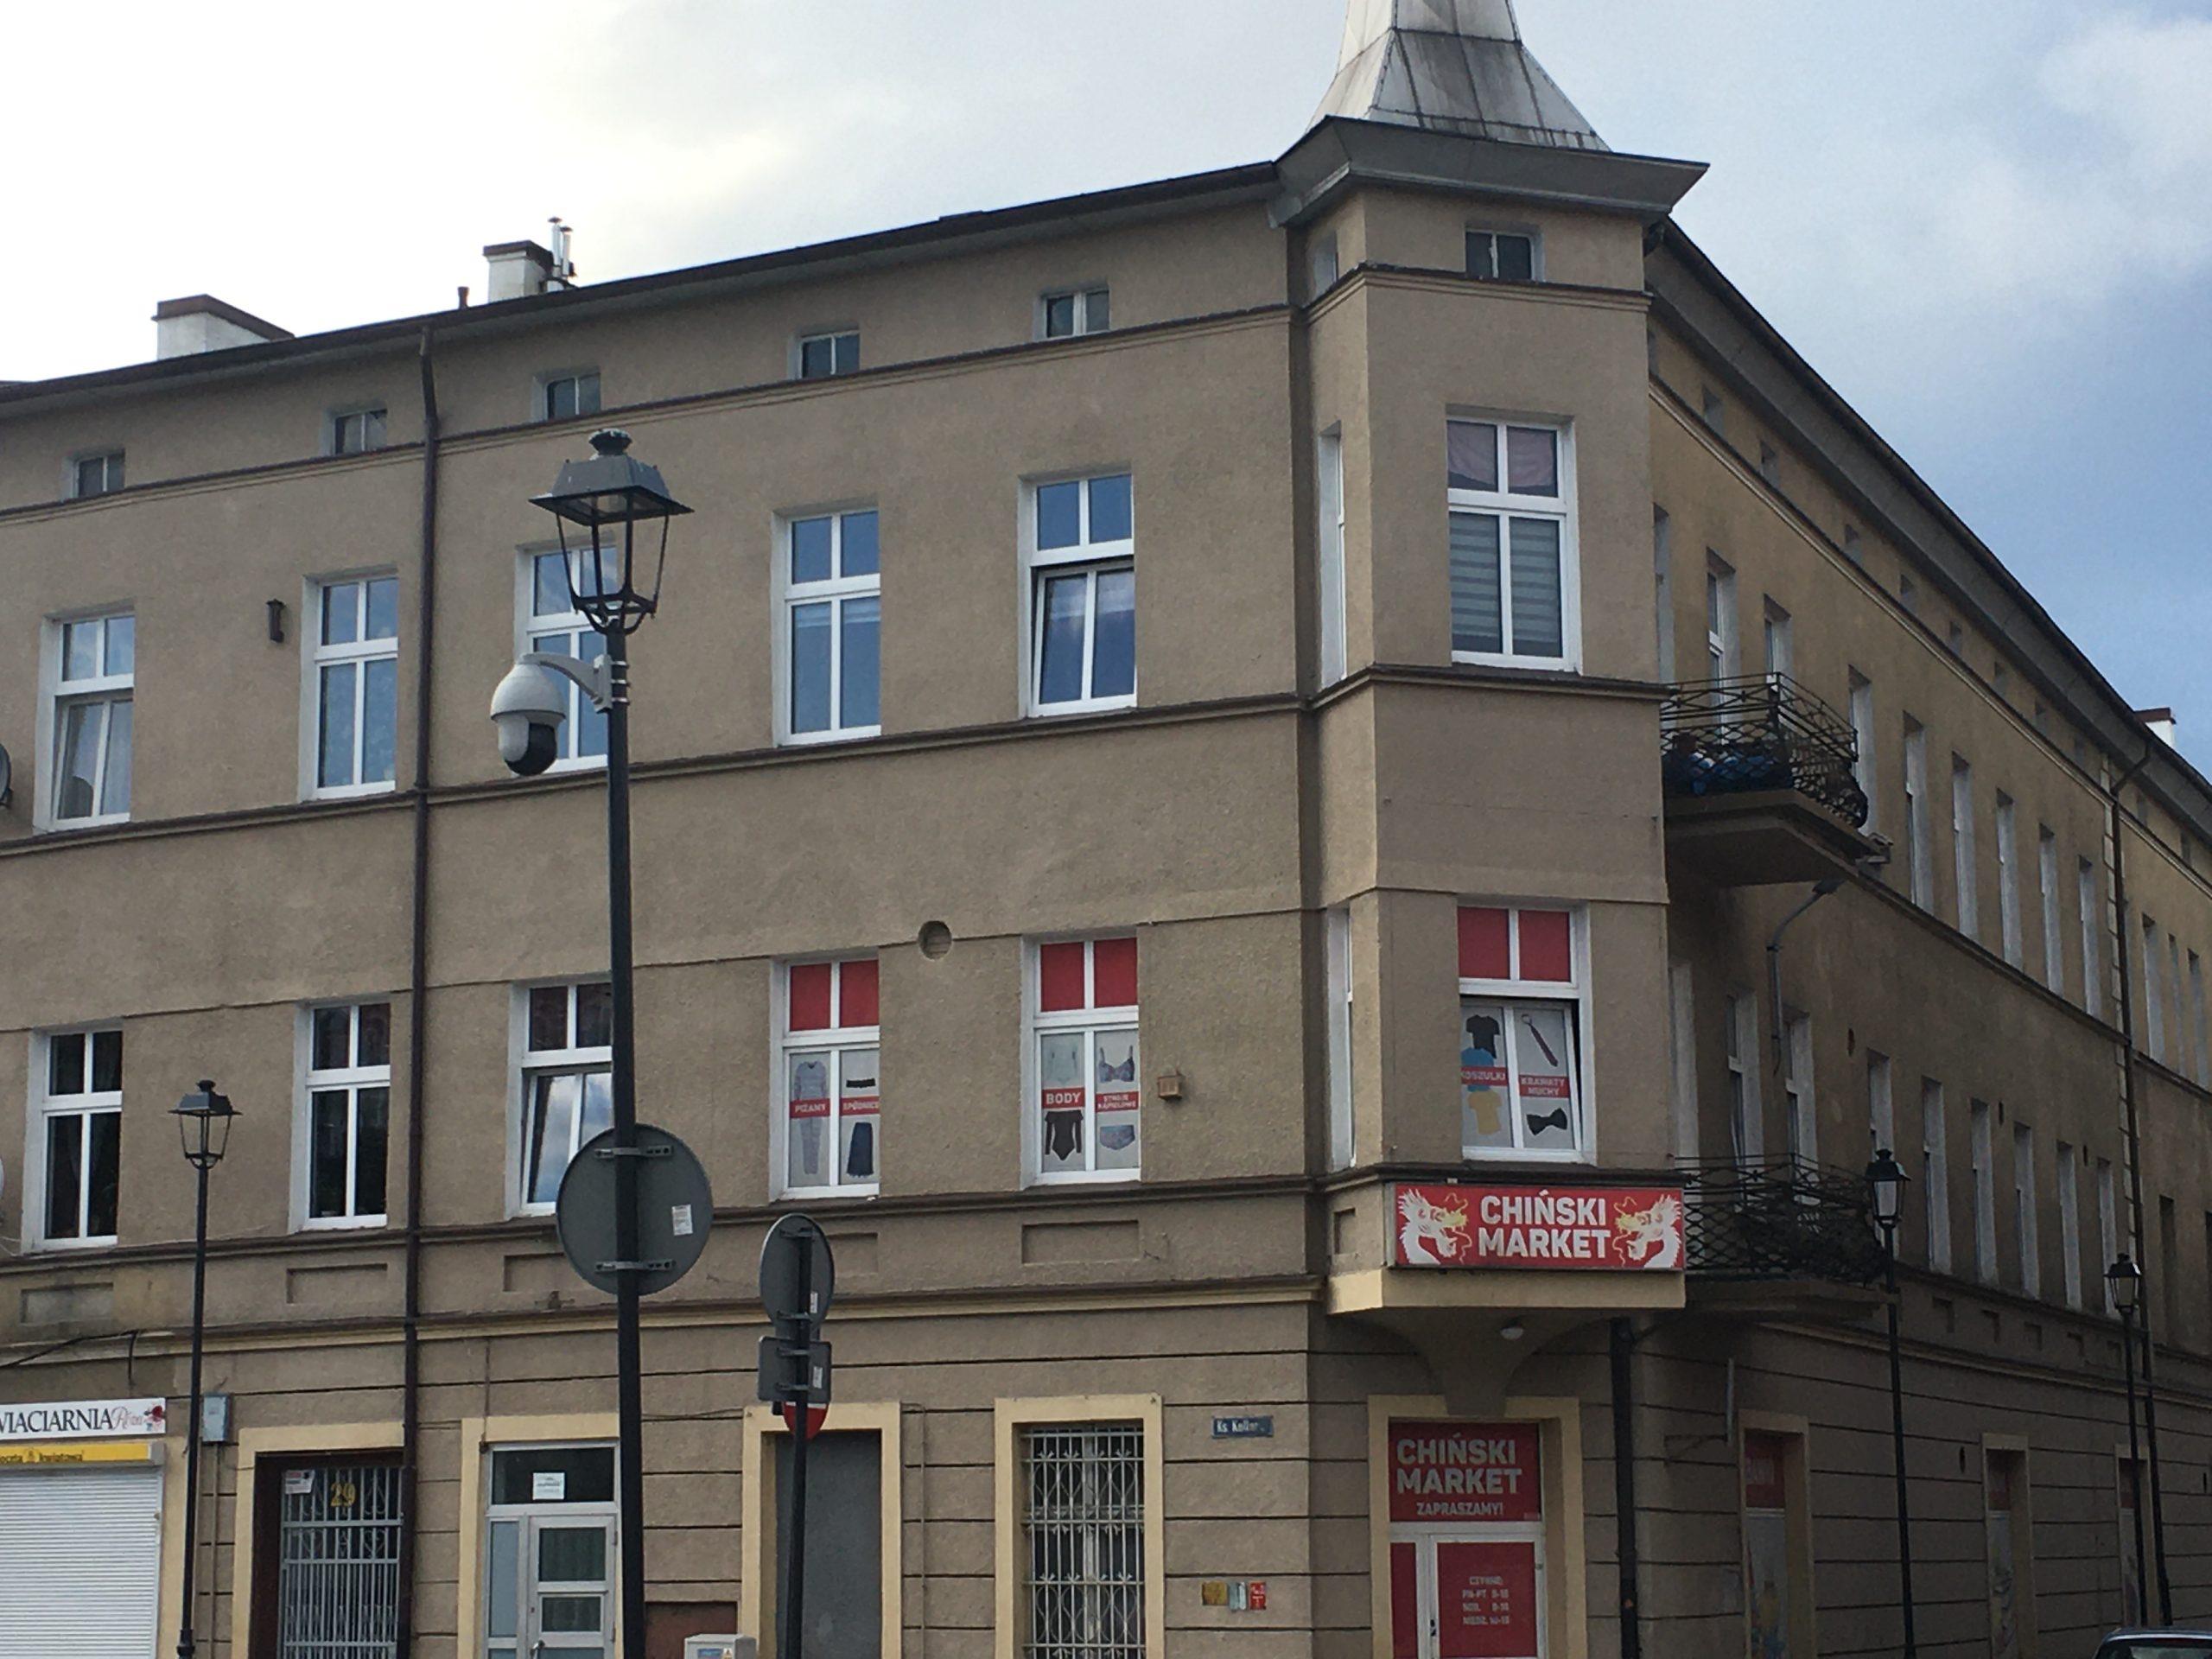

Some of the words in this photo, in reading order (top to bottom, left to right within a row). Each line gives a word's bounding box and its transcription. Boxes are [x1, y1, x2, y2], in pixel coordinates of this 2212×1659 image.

[1046, 1091, 1082, 1105] BODY
[1480, 1189, 1607, 1226] CHIŃSKI
[1478, 1227, 1611, 1259] MARKET
[1396, 1432, 1516, 1465] CHIŃSKI
[330, 1482, 356, 1508] 29
[1396, 1467, 1522, 1495] MARKET
[1416, 1502, 1504, 1516] ZAPRASZAMY!
